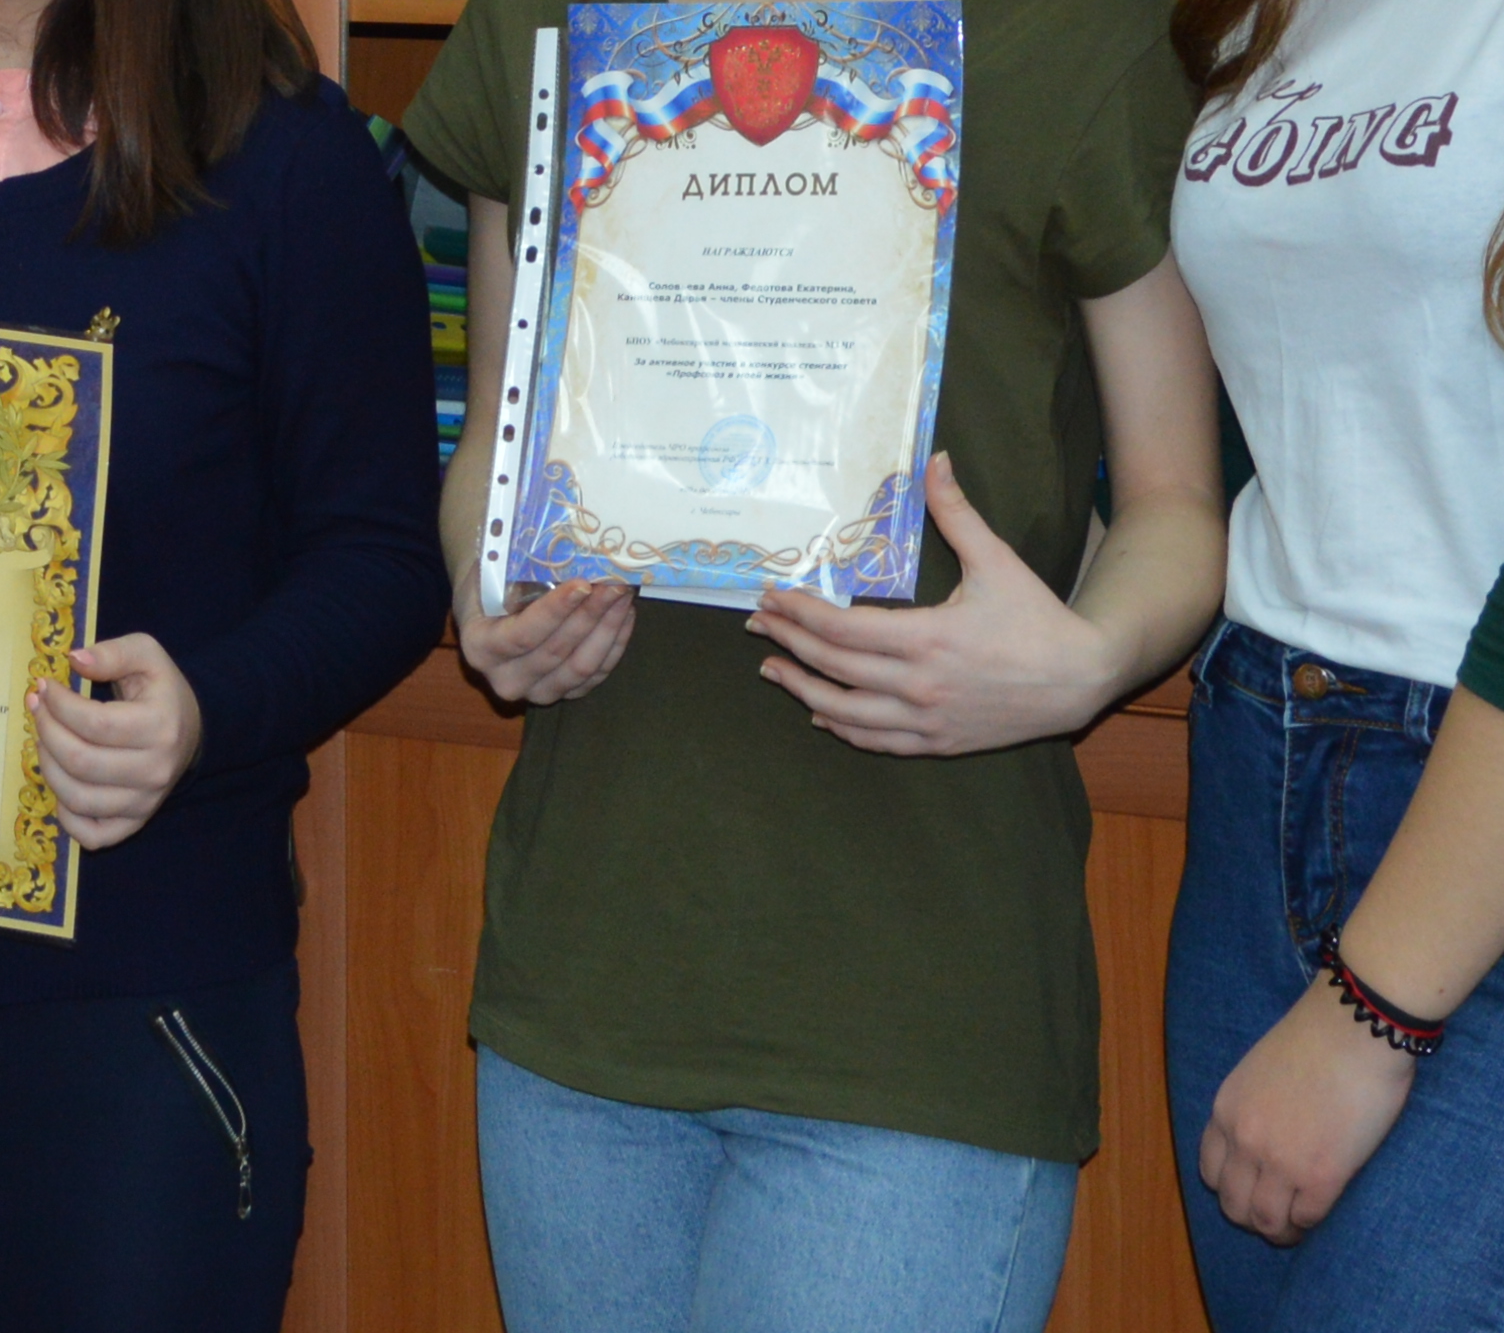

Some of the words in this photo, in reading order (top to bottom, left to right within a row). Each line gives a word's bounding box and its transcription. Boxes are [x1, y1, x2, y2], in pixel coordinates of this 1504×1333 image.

[1183, 91, 1459, 187] GOING
[682, 172, 840, 201] ДИПЛОМ
[701, 246, 793, 257] НАГРАЖДАЮТСЯ
[707, 282, 737, 292] Анна,
[795, 283, 857, 294] Екатерина,
[719, 295, 754, 303] члены
[756, 295, 838, 305] Студенческого
[839, 297, 877, 305] совета
